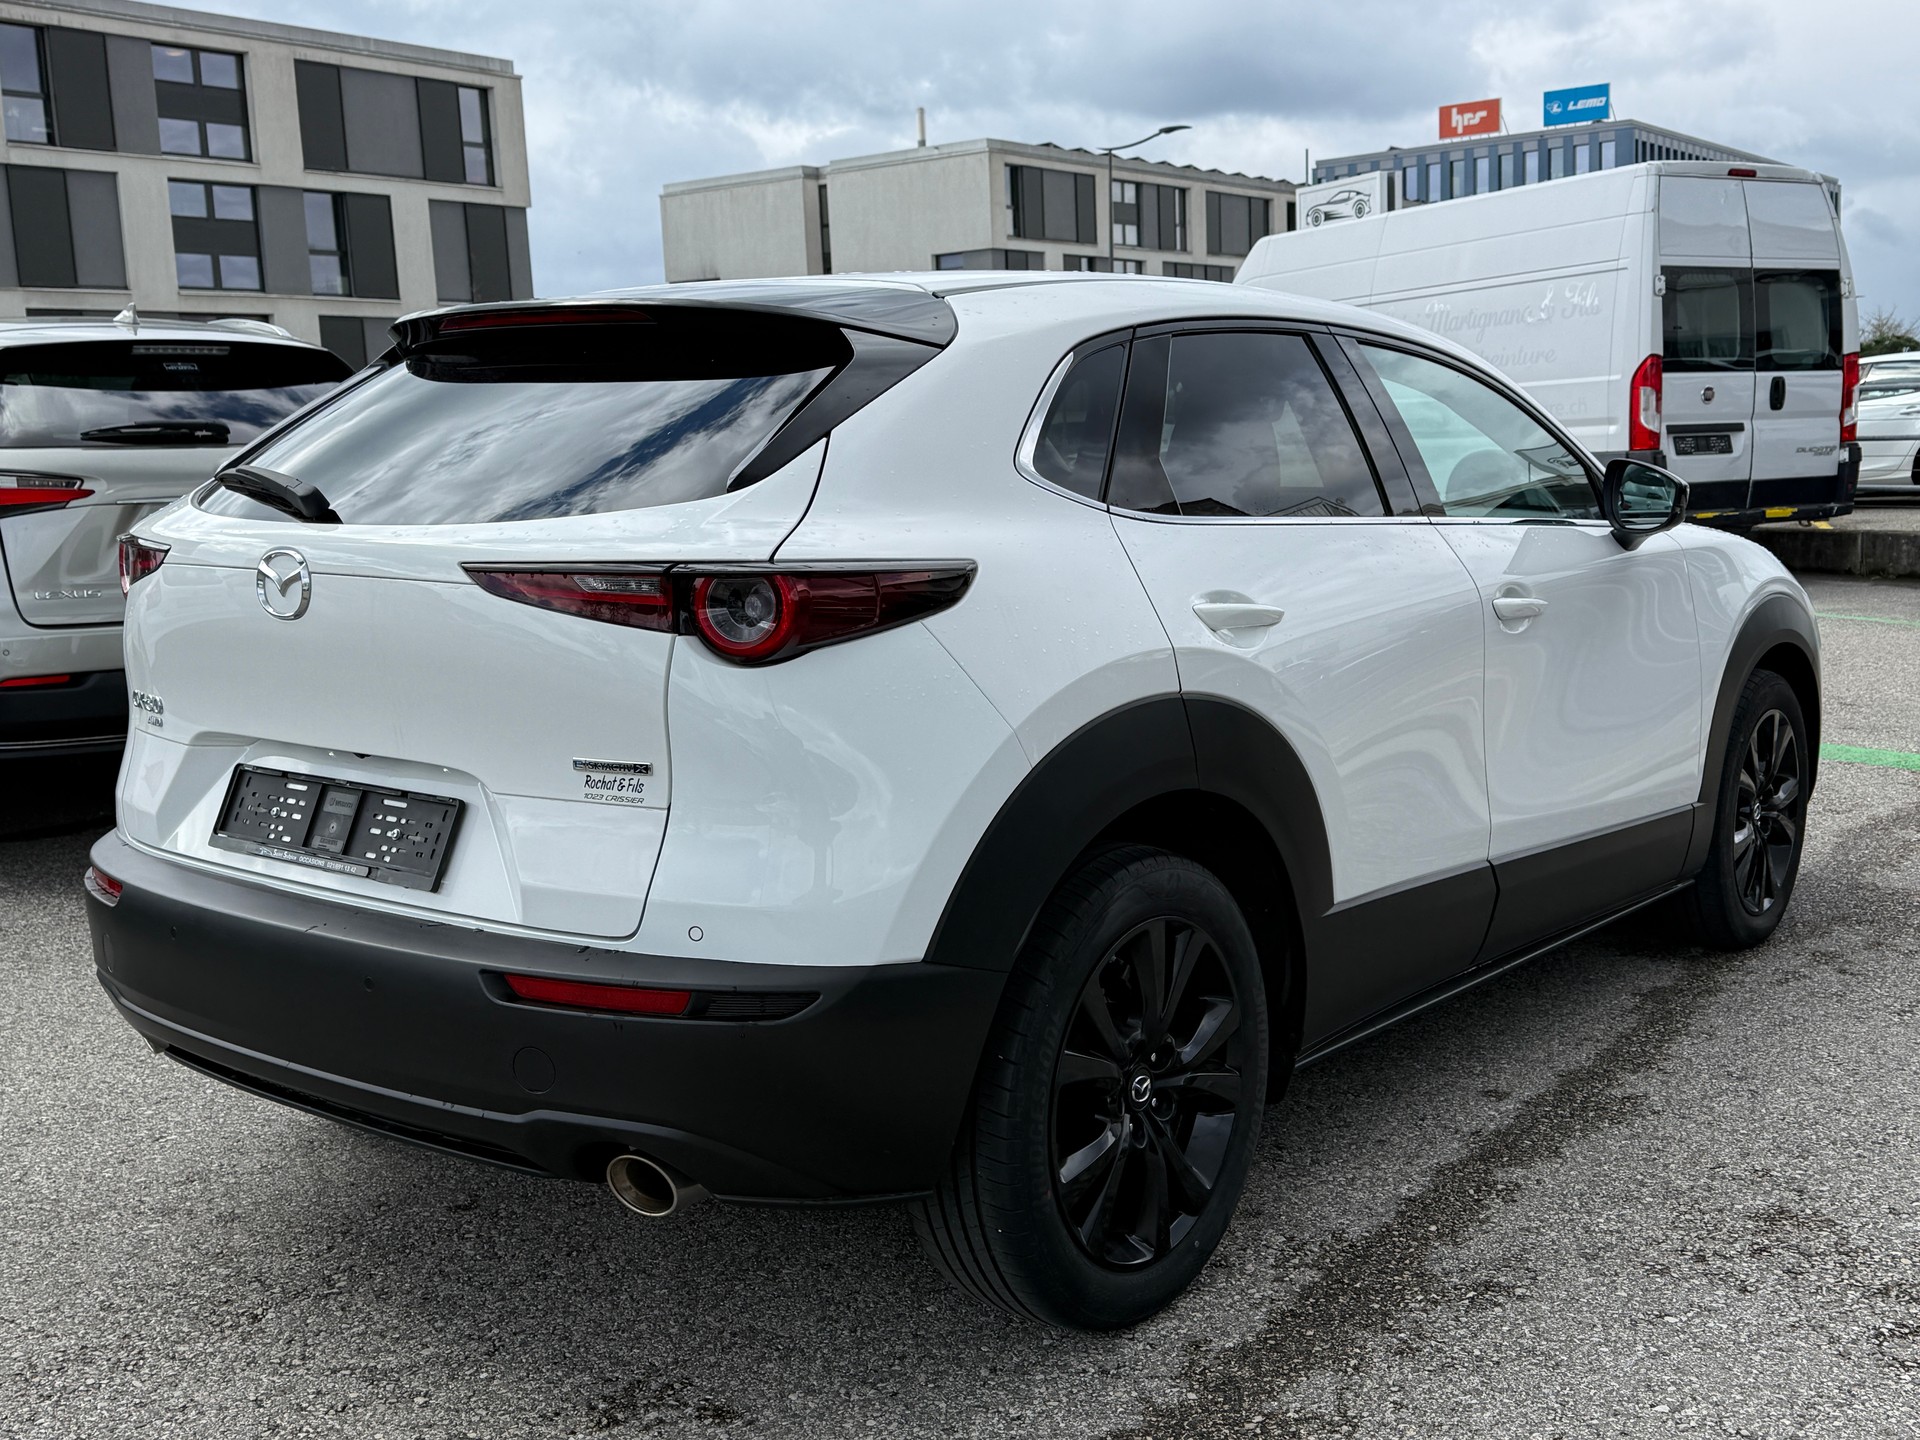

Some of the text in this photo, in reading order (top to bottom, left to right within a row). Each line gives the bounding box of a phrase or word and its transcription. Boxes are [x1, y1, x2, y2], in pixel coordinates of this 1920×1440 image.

[1567, 97, 1607, 111] LEMO
[1452, 107, 1487, 134] hrs
[35, 590, 101, 600] LEXUS
[584, 774, 645, 793] Rochat & Fils
[583, 792, 645, 804] 1023 CRISSIER
[299, 855, 325, 867] OCCASIONS
